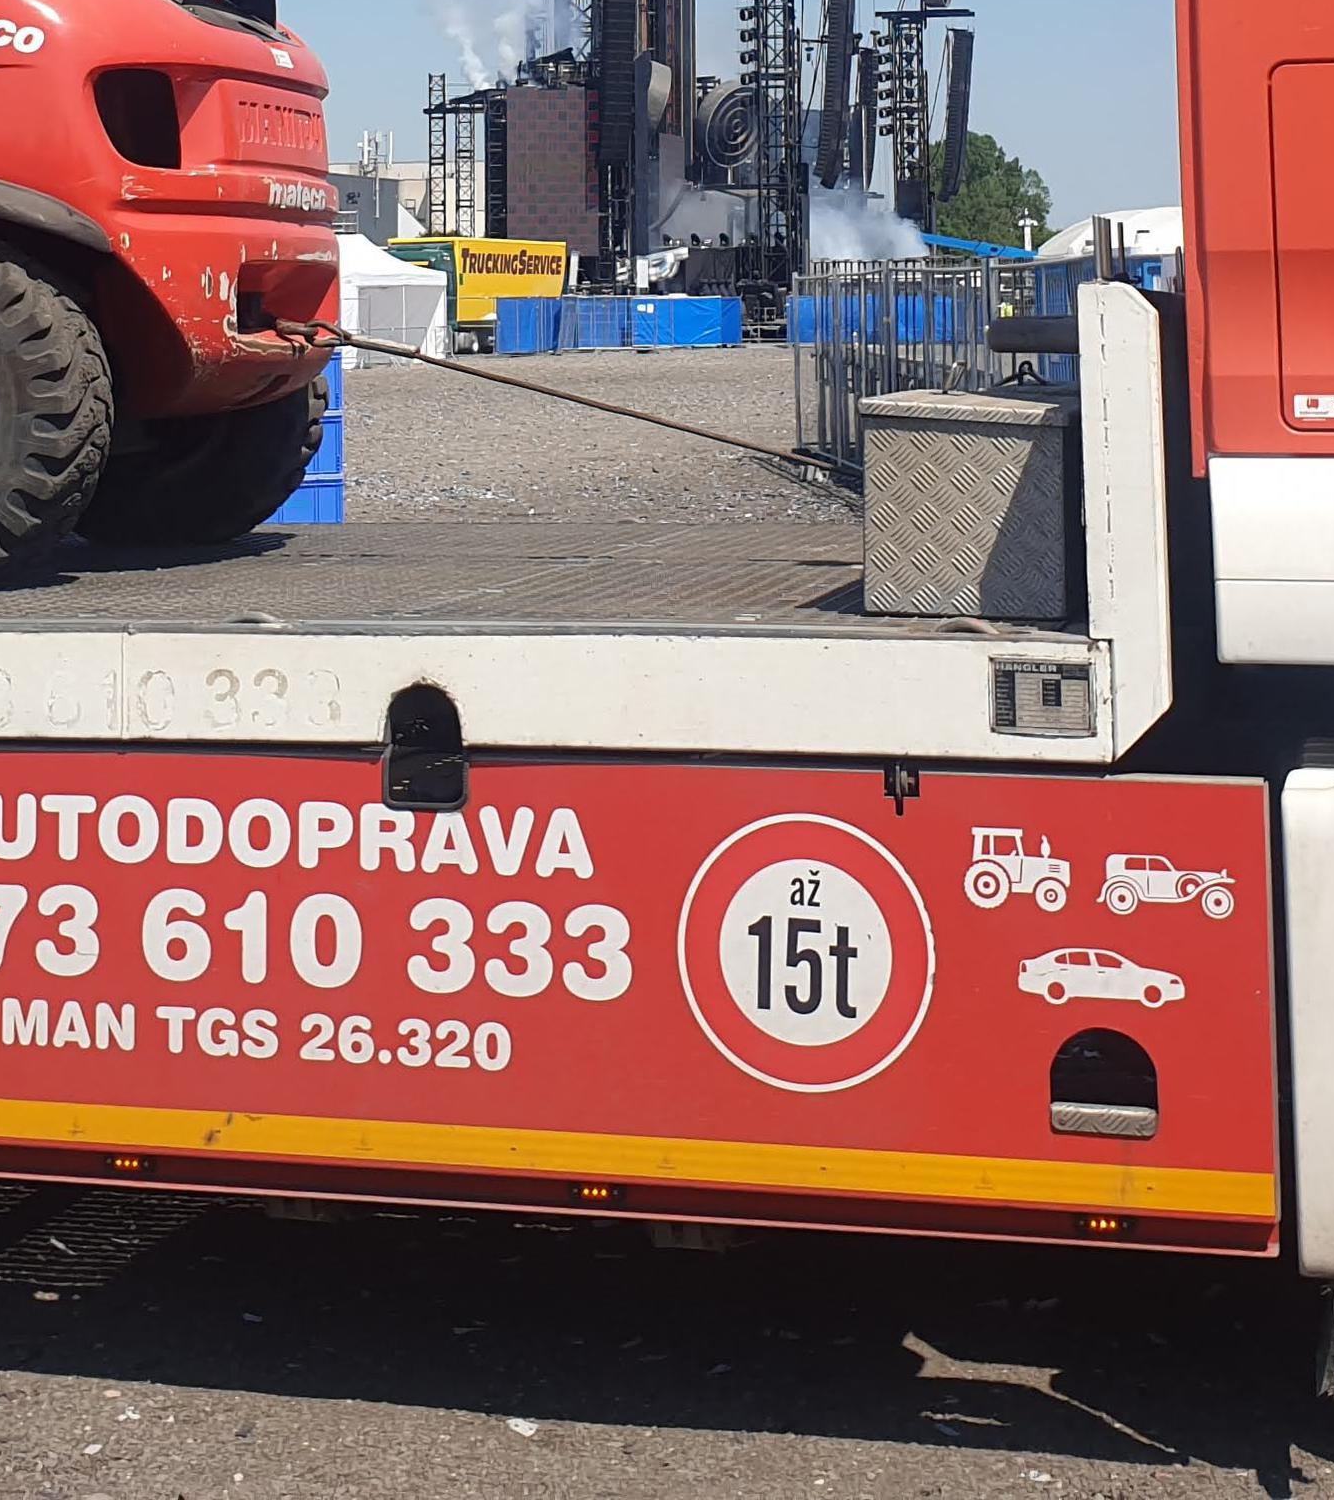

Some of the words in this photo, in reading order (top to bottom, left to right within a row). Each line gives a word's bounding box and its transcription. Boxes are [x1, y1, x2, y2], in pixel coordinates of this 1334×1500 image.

[789, 869, 822, 909] až
[141, 886, 363, 991] 610
[406, 896, 633, 1003] 333
[747, 914, 858, 1020] 15t
[2, 997, 136, 1052] MAN
[155, 1005, 279, 1059] TGS
[299, 1011, 512, 1073] 26.320
